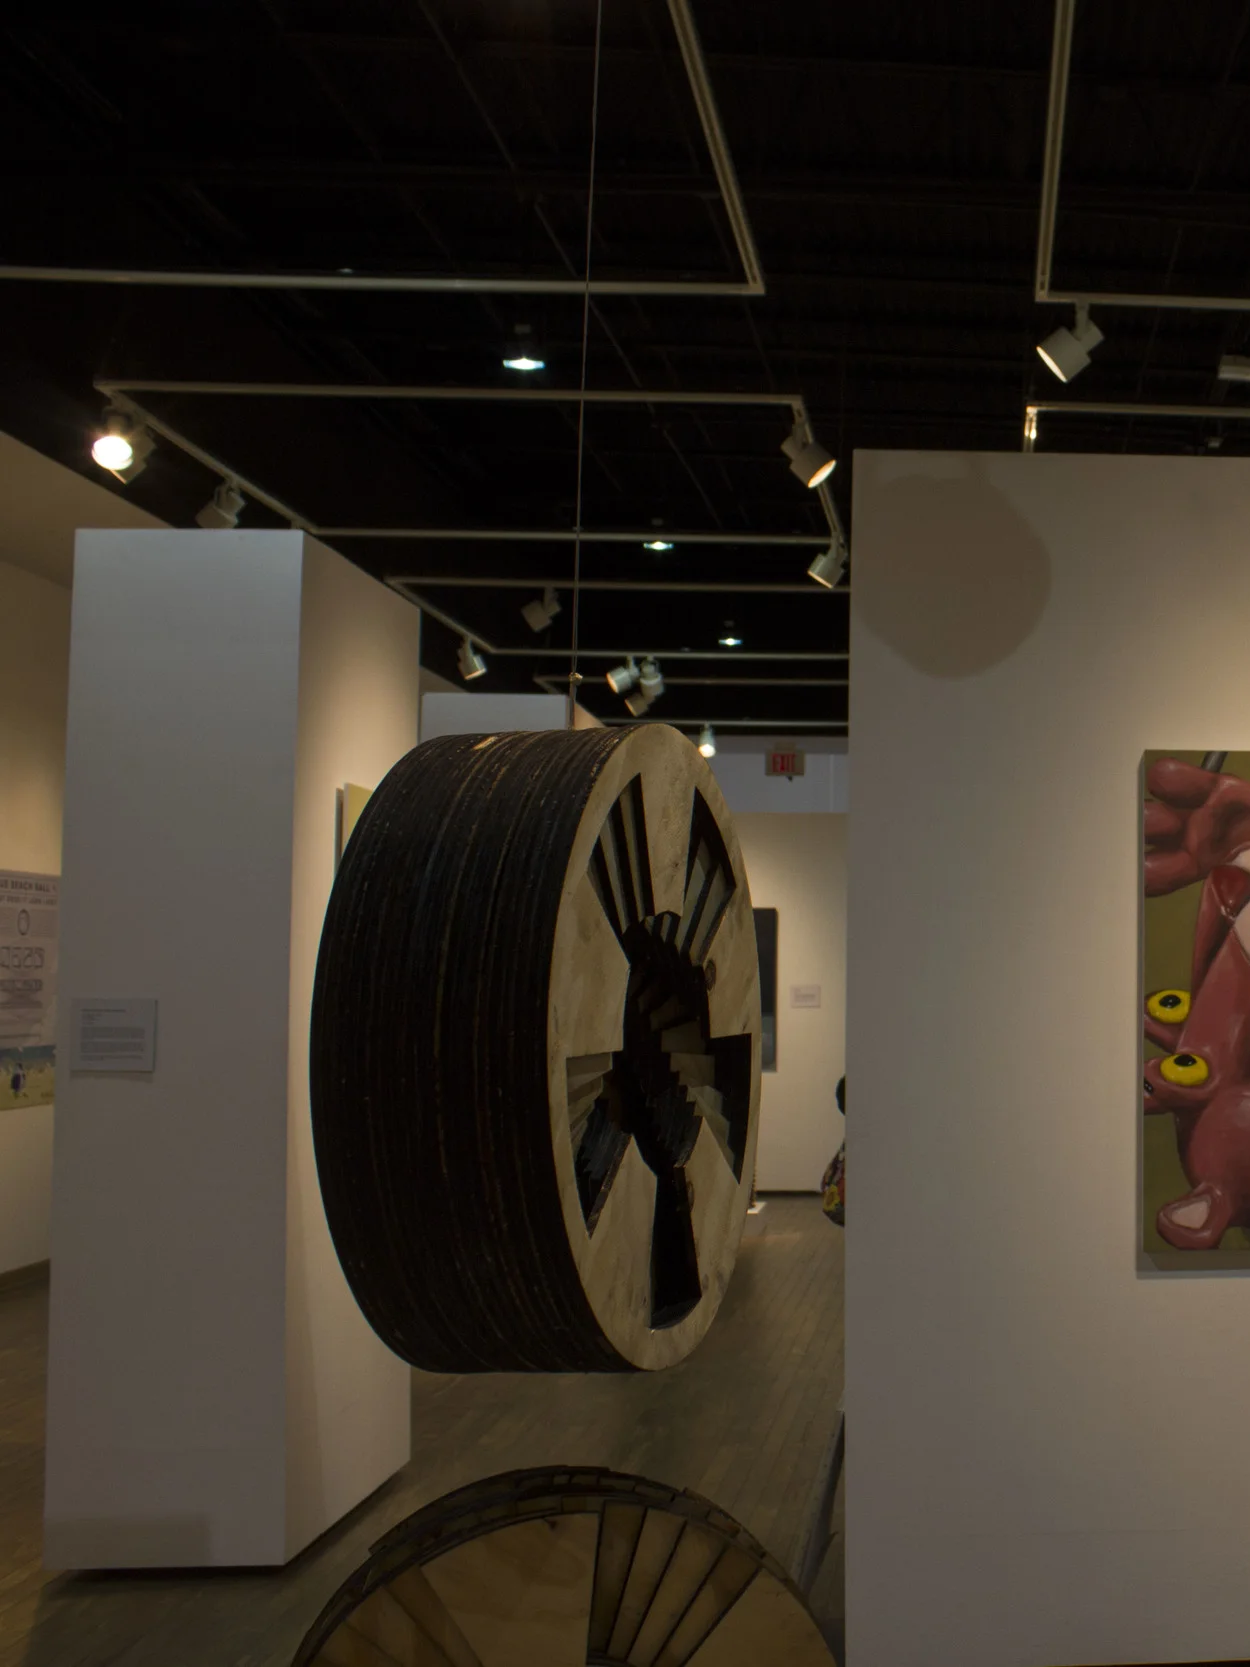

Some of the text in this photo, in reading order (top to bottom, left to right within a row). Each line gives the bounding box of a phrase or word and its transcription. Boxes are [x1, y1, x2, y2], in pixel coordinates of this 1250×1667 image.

[771, 753, 796, 773] EXIT
[10, 879, 33, 891] BEACH
[34, 881, 51, 894] BALL
